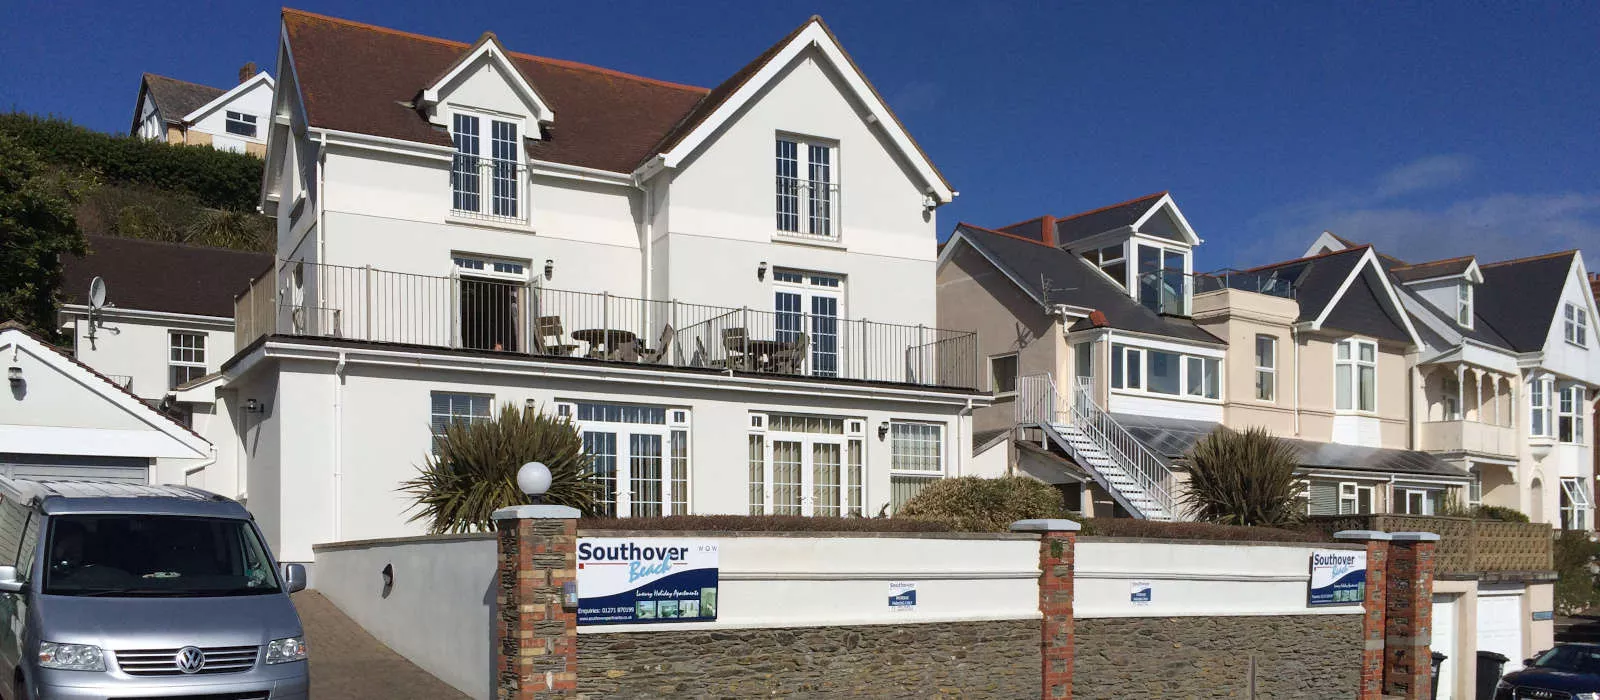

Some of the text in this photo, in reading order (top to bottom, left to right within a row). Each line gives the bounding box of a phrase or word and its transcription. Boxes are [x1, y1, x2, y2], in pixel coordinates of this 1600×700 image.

[578, 542, 688, 561] Southover
[1314, 553, 1355, 566] Southover
[628, 554, 672, 583] Beach
[654, 589, 673, 598] Holiday
[673, 589, 699, 597] Apartments
